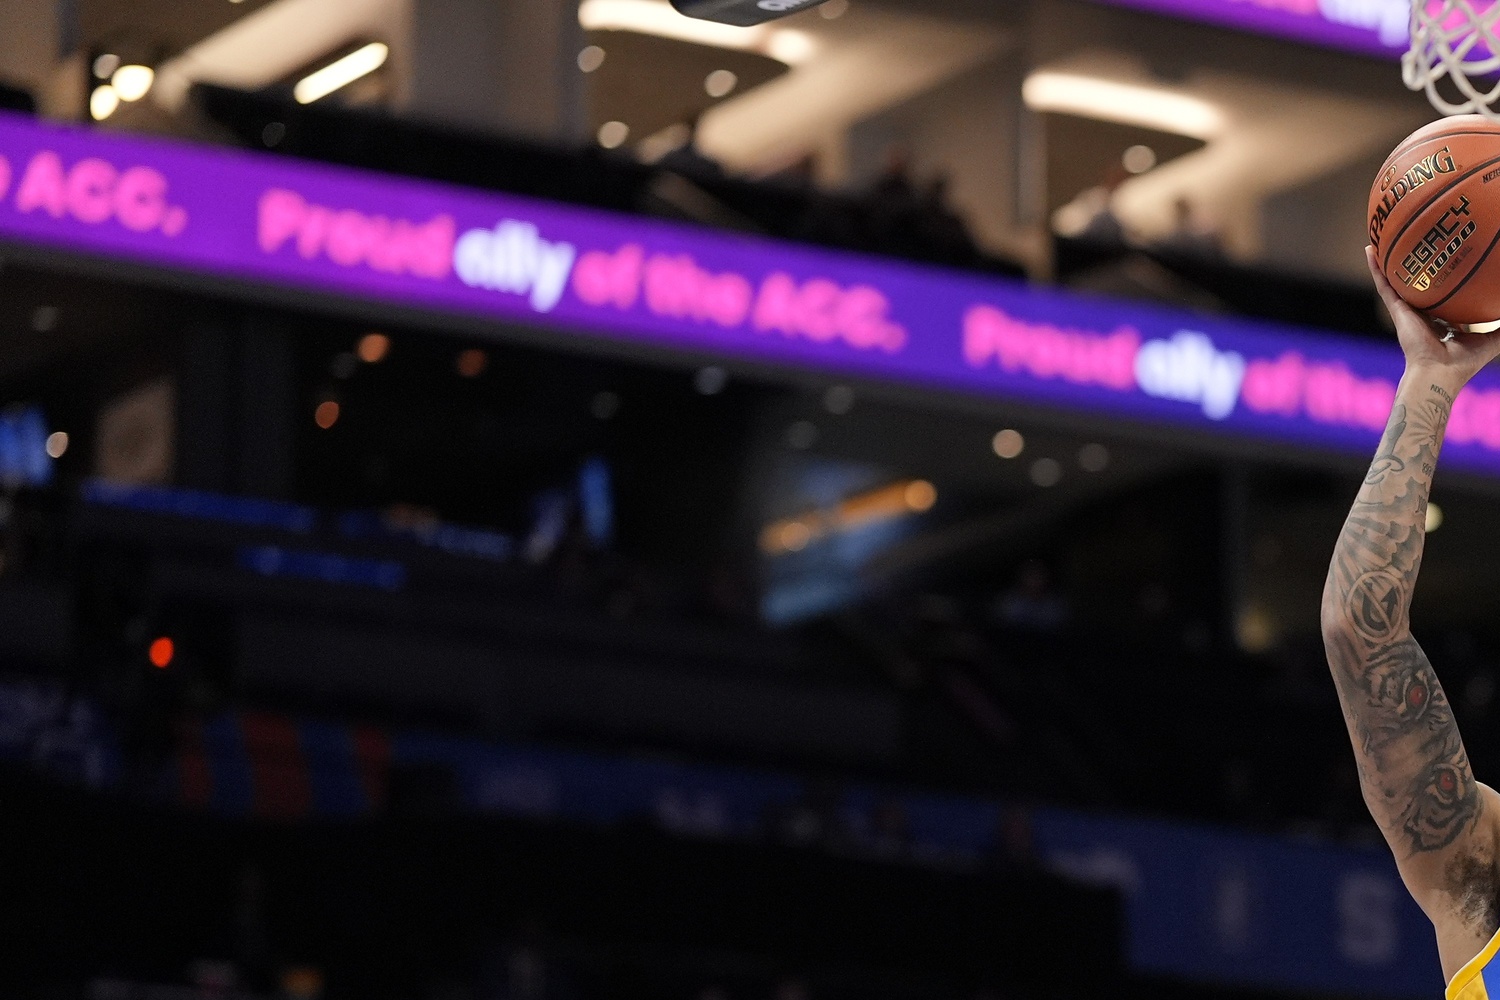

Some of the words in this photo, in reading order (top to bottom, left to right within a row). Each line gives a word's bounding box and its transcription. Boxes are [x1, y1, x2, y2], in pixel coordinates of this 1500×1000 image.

[258, 187, 456, 280] Proud
[453, 218, 576, 313] ally
[1394, 195, 1470, 286] LEGACY
[1426, 220, 1477, 278] 1000
